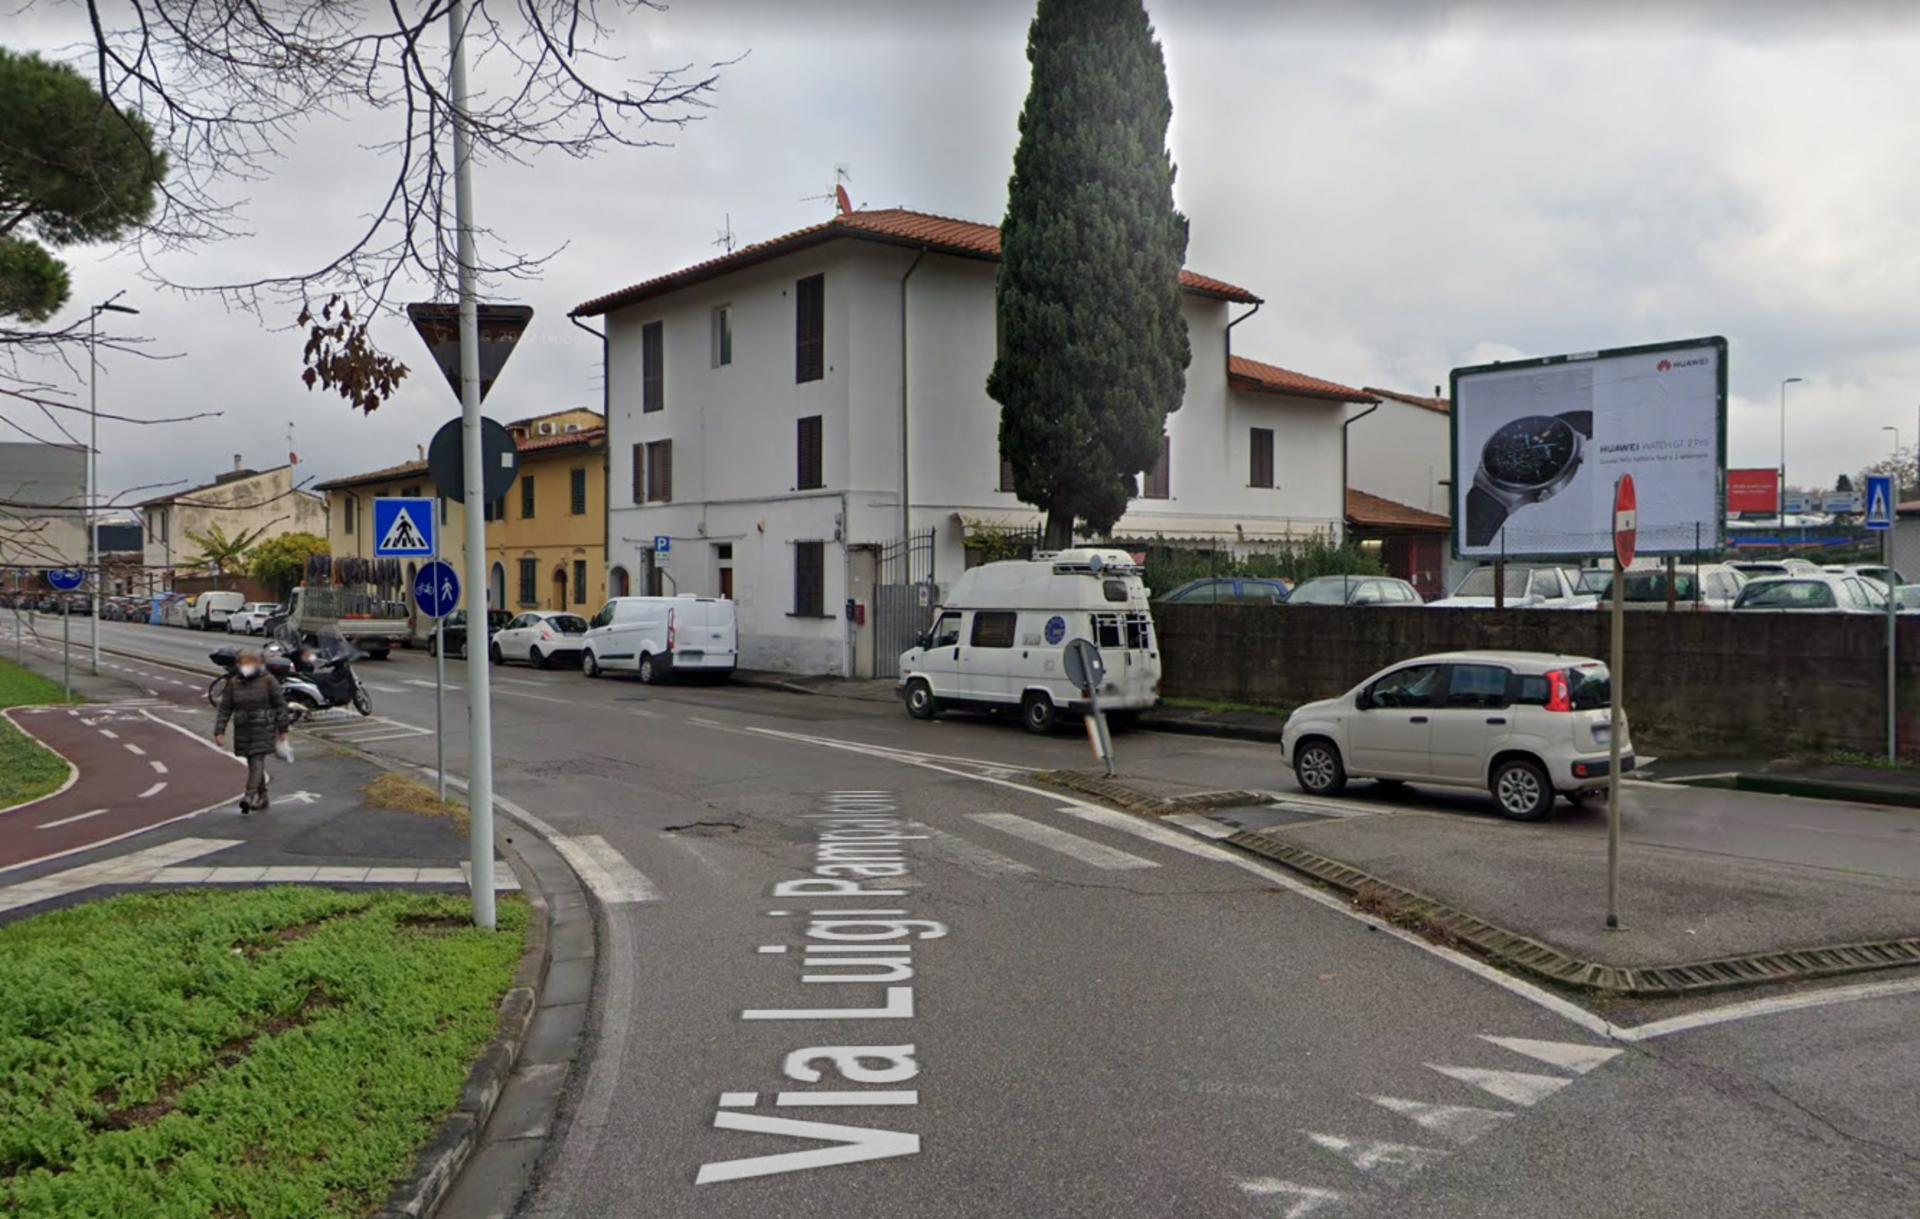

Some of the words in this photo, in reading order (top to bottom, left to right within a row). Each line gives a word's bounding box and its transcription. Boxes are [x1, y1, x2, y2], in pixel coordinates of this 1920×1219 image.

[1672, 357, 1709, 368] HUAWEI
[1600, 443, 1640, 453] HUAWEI
[657, 538, 667, 550] P
